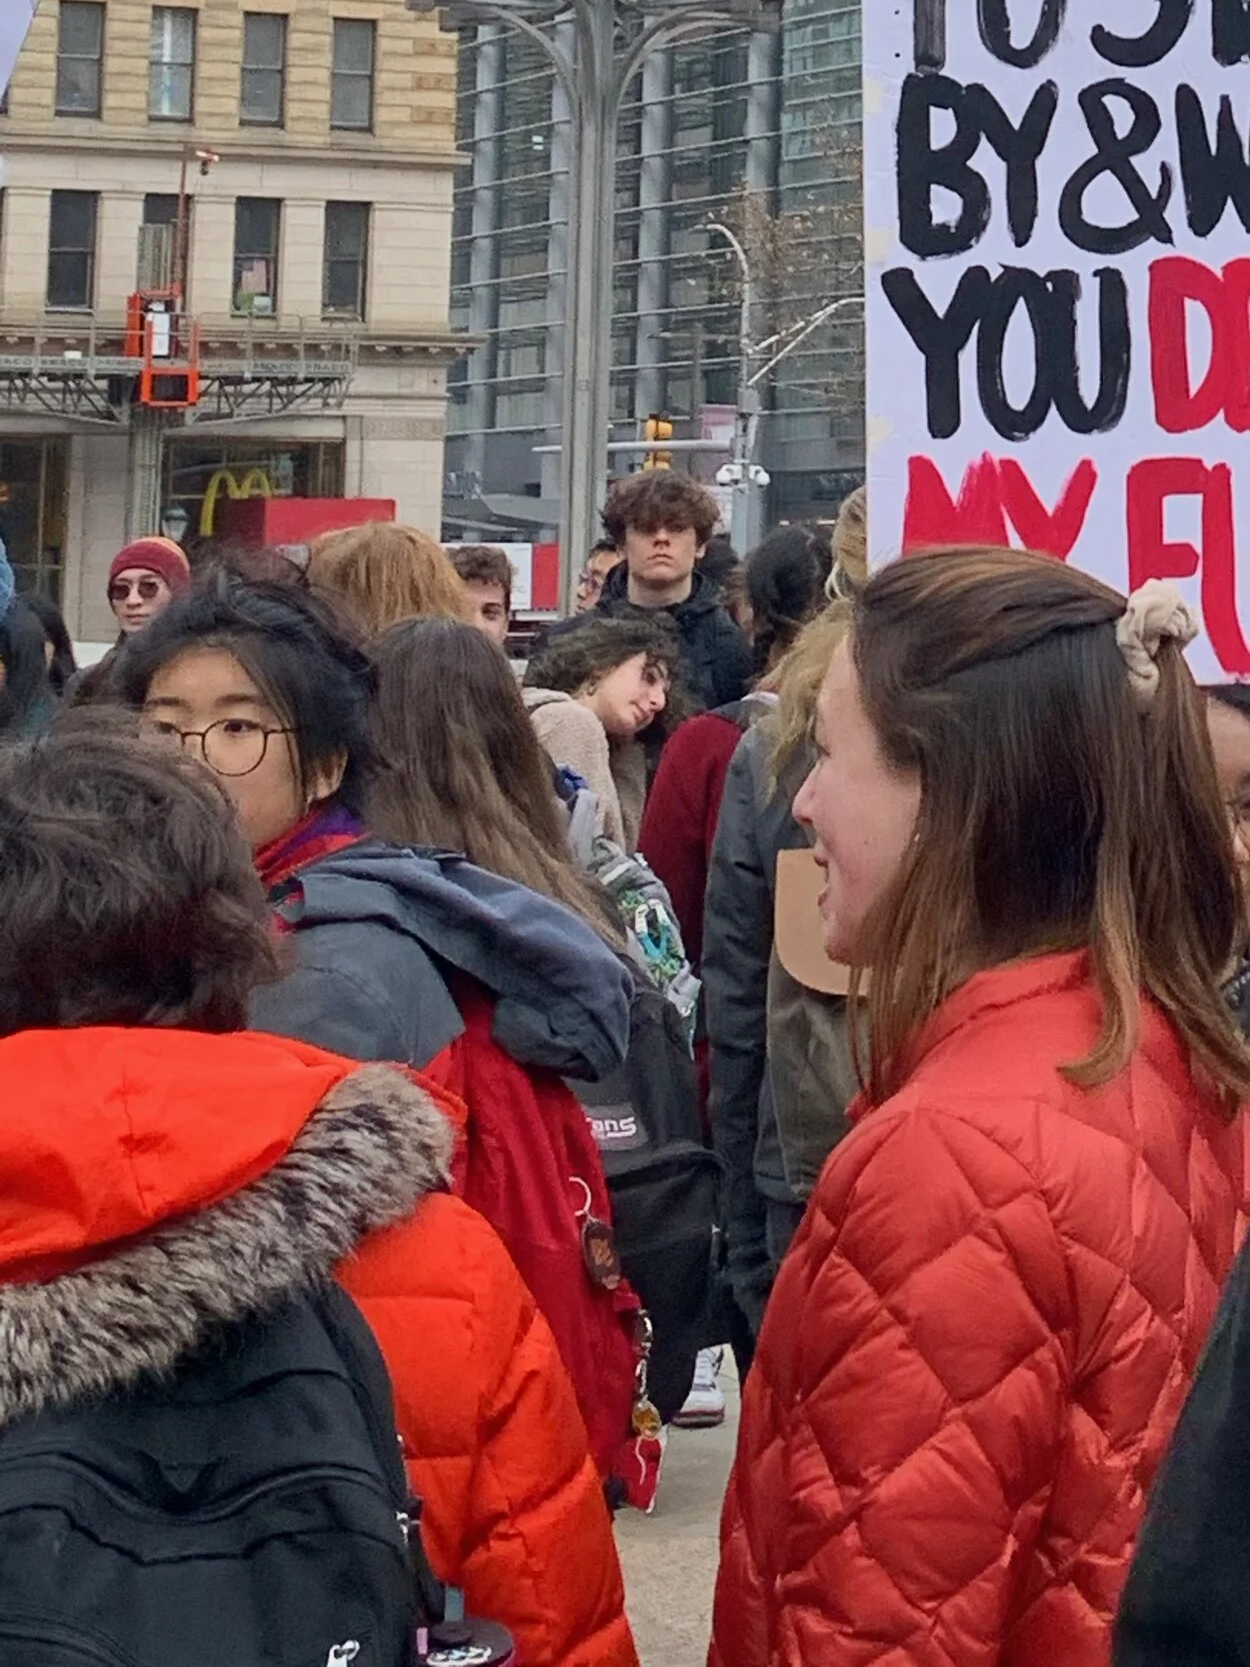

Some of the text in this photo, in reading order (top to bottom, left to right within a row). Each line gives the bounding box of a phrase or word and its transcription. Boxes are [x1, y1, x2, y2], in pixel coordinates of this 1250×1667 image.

[896, 71, 1058, 260] BY
[1058, 78, 1174, 254] &
[881, 262, 1130, 441] YOU
[586, 1116, 637, 1138] ans
